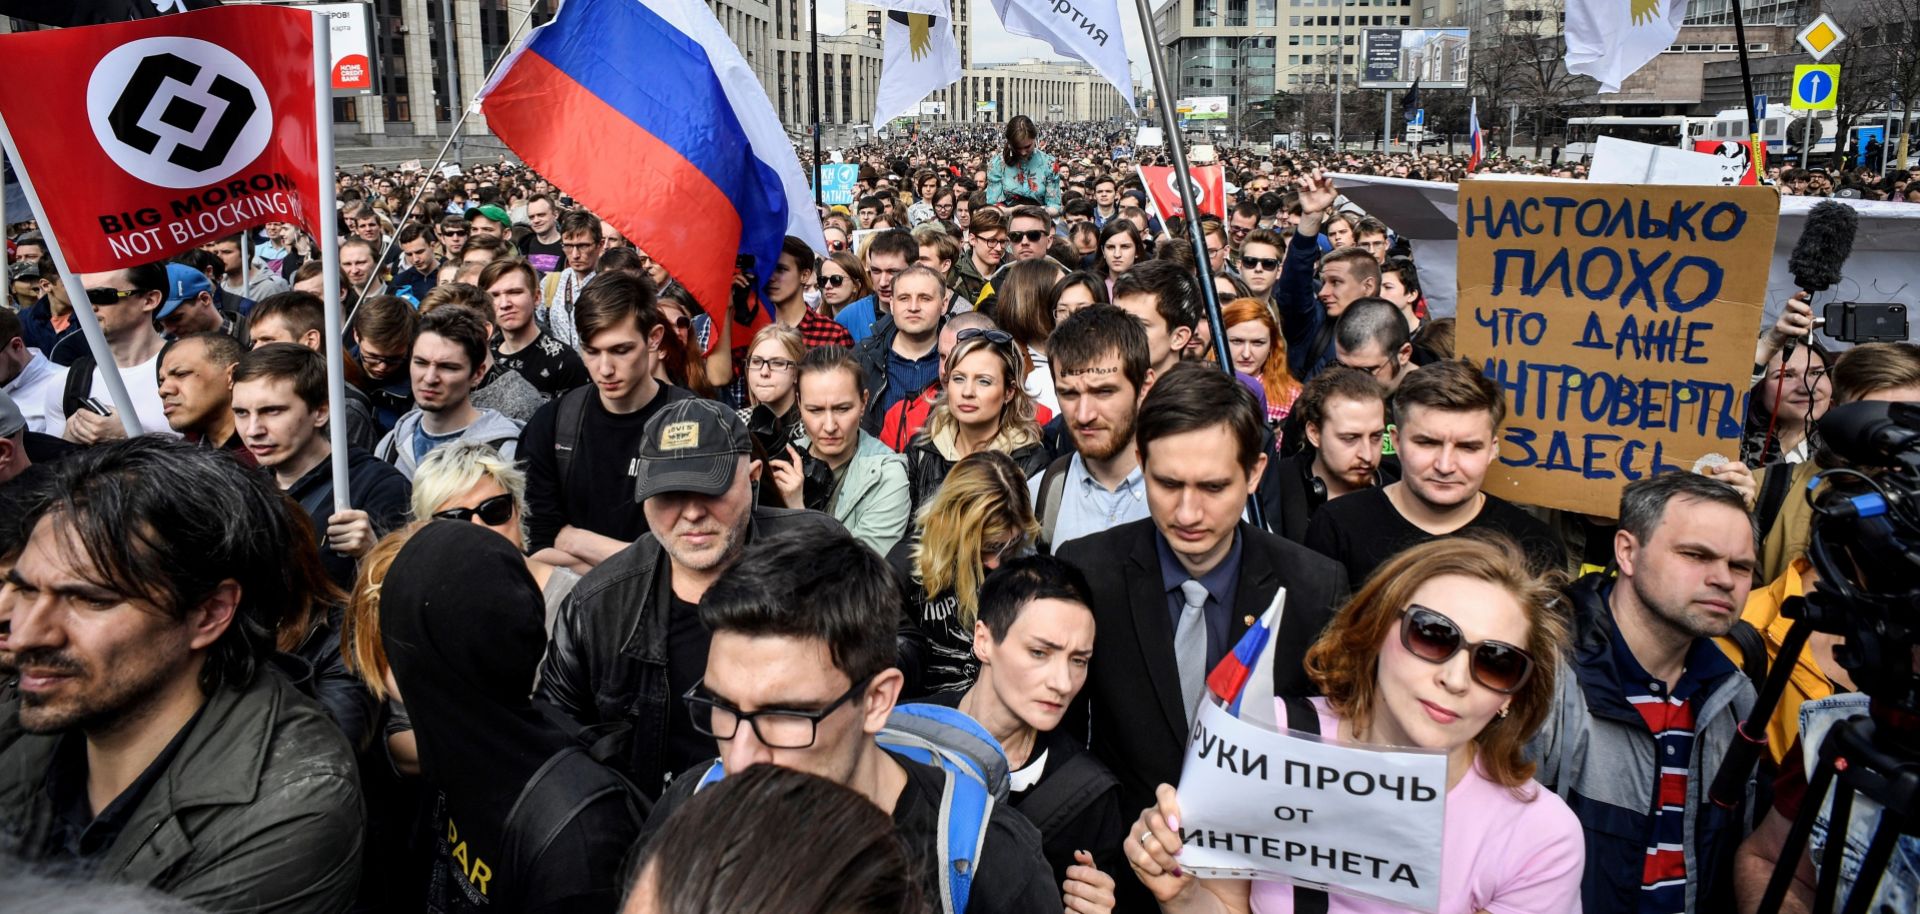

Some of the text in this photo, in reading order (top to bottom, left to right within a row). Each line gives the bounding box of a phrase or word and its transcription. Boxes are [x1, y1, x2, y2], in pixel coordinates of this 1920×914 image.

[1047, 0, 1109, 47] ртия
[98, 208, 163, 235] BIG
[108, 227, 164, 260] NOT
[168, 191, 288, 245] BLOCKING
[1465, 195, 1748, 242] НАСТОЛЬКО
[1490, 246, 1725, 314] ПЛОХО
[1474, 307, 1714, 364] ЧТО ДАЖЕ
[1482, 357, 1752, 440] НТРОВЕРТЫ
[1499, 426, 1684, 481] ЗДЕСЬ
[1191, 719, 1437, 802] РУКИ ПРОЧЬ
[1178, 827, 1420, 889] ИНТЕРНЕТА
